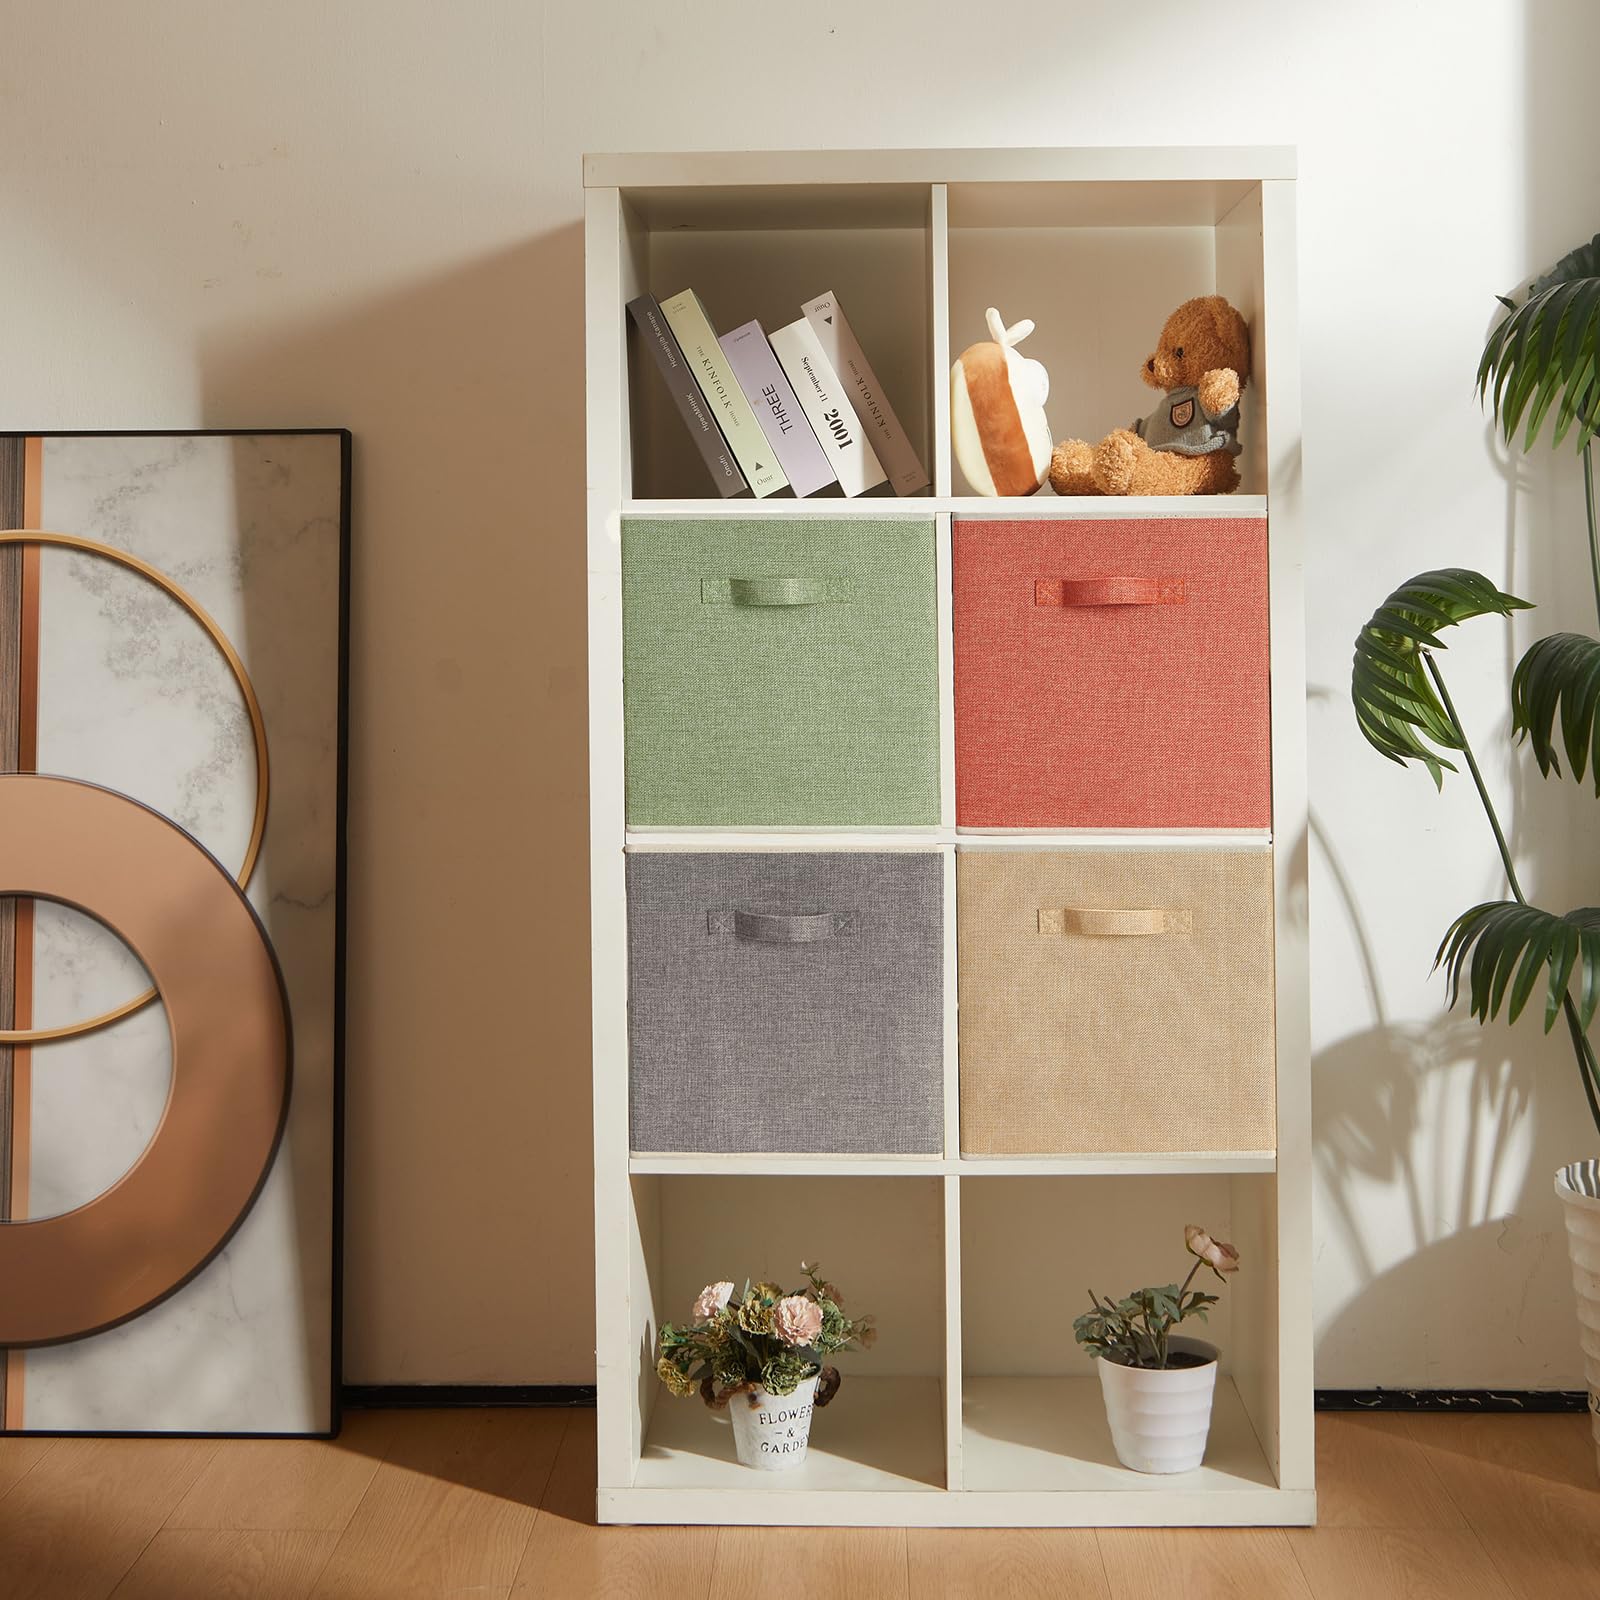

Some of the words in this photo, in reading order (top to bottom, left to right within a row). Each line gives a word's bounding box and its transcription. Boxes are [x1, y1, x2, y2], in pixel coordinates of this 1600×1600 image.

[702, 358, 733, 409] KINFOLK
[800, 356, 823, 393] September
[761, 384, 793, 435] THREE
[856, 377, 886, 428] KINFOLK
[823, 408, 853, 450] 2001
